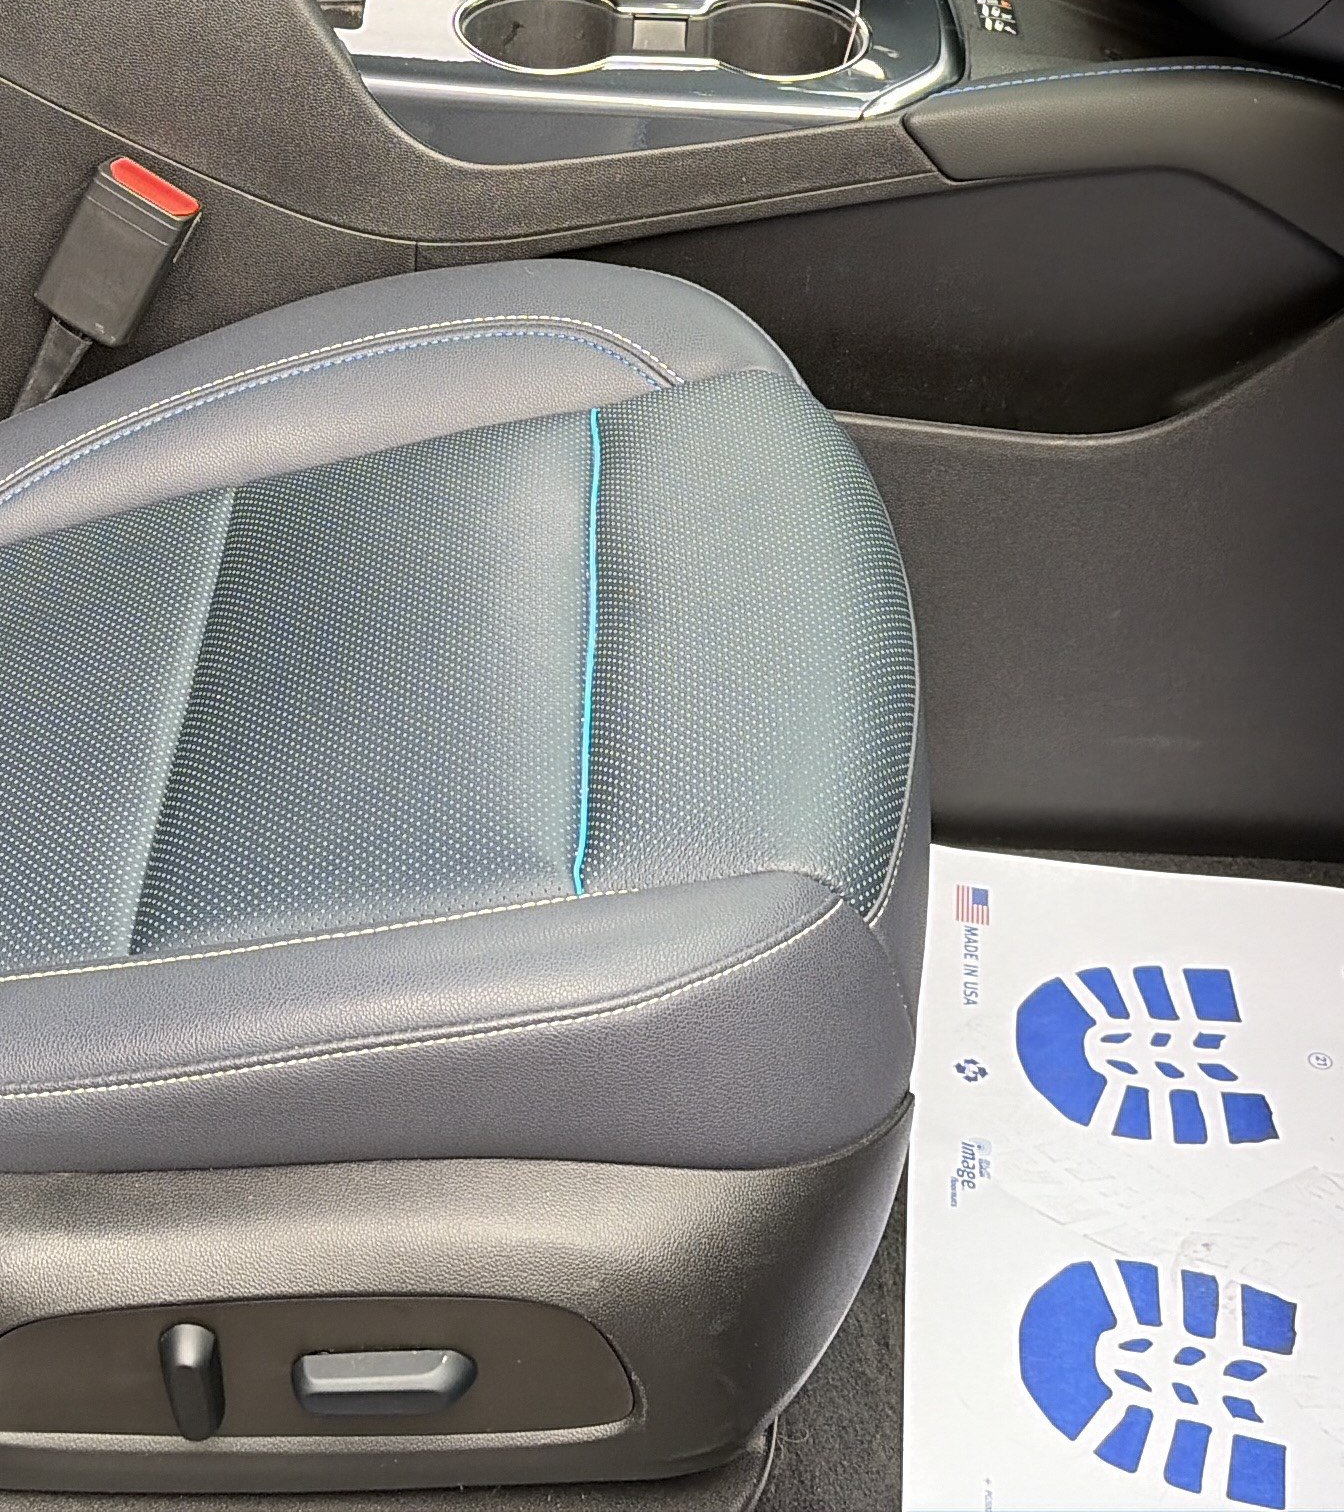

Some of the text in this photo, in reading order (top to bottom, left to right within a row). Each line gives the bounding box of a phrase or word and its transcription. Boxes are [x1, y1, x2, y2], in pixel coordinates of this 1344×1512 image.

[963, 925, 979, 1006] MADE IN USA
[957, 1141, 982, 1189] image
